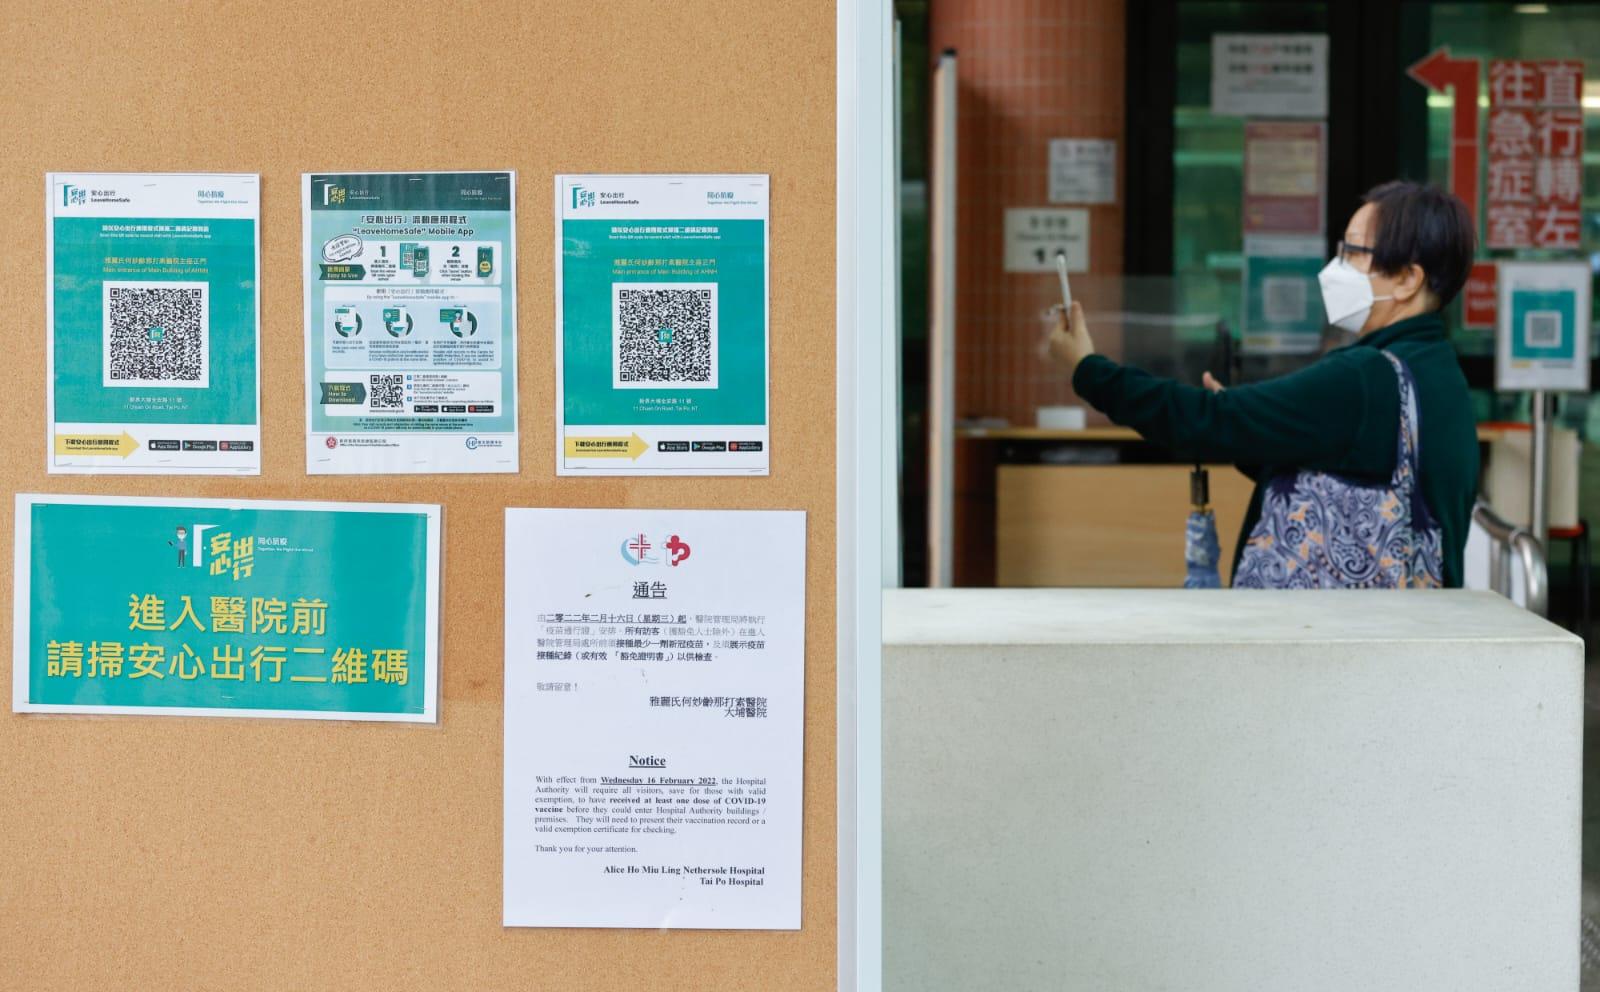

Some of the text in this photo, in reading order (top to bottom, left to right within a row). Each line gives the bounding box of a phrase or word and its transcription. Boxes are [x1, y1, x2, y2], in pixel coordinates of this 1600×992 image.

[1489, 61, 1533, 248] 往急症室
[1537, 63, 1580, 247] 直行轉左
[428, 228, 456, 237] Mobile
[458, 228, 474, 237] App
[380, 246, 386, 257] 1
[452, 246, 460, 257] 2
[210, 532, 254, 581] 安心出行
[632, 581, 667, 599] 通告
[128, 594, 329, 636] 進入醫院前
[46, 640, 410, 686] 請掃安心出行二維碼
[649, 696, 768, 707] 雅麗氏何妙齡那打素醫院
[724, 707, 767, 718] 大埔醫院
[629, 755, 666, 768] Notice
[601, 777, 643, 785] Wednesday
[736, 778, 766, 786] Hospital
[536, 786, 569, 794] Authority
[656, 807, 686, 815] Hospital
[555, 826, 592, 834] exemption
[643, 826, 676, 835] checking.
[662, 866, 680, 875] Ling
[730, 867, 765, 876] Hospital
[729, 878, 764, 887] Hospital
